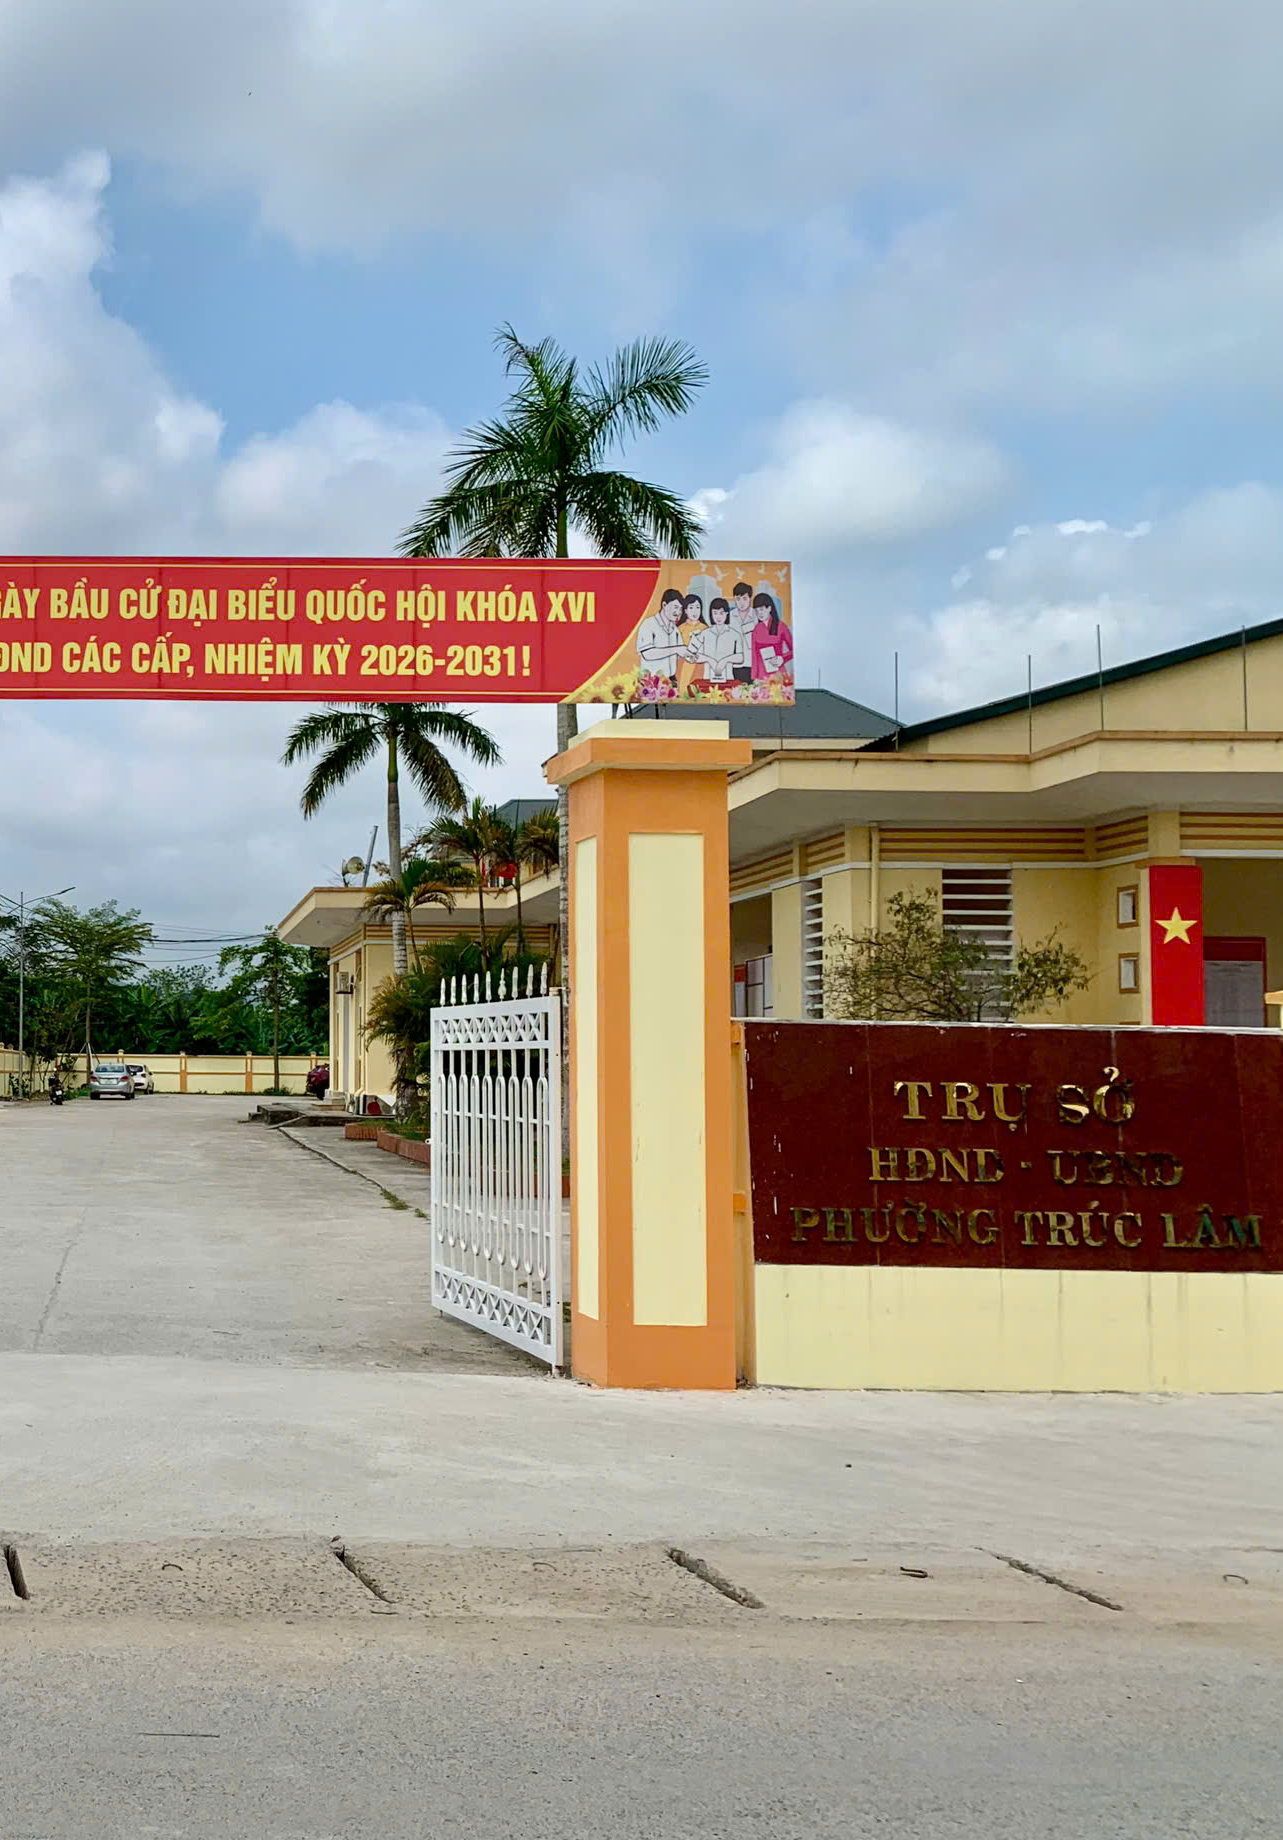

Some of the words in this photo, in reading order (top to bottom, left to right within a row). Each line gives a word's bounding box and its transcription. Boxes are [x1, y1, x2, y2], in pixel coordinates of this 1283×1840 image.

[49, 577, 110, 620] BẦU
[119, 577, 162, 620] CỬ
[167, 590, 218, 627] ĐẠI
[227, 577, 296, 621] BIỂU
[305, 578, 386, 625] QUỐC
[396, 583, 446, 629] HỘI
[456, 583, 539, 623] KHÓA
[546, 591, 596, 623] XVI
[61, 635, 122, 674] CÁC
[131, 631, 195, 678] CẤP,
[204, 636, 303, 682] NHIỆM
[312, 636, 352, 676] KỲ
[359, 644, 531, 677] 2026-2031!
[893, 1081, 1032, 1132] TRỤ
[1057, 1066, 1135, 1124] SỞ
[868, 1147, 1005, 1183] HĐND
[1046, 1150, 1184, 1186] UBND
[789, 1198, 1000, 1245] PHƯỜNG
[1014, 1200, 1142, 1248] TRÚC
[1160, 1203, 1263, 1249] LÂM
